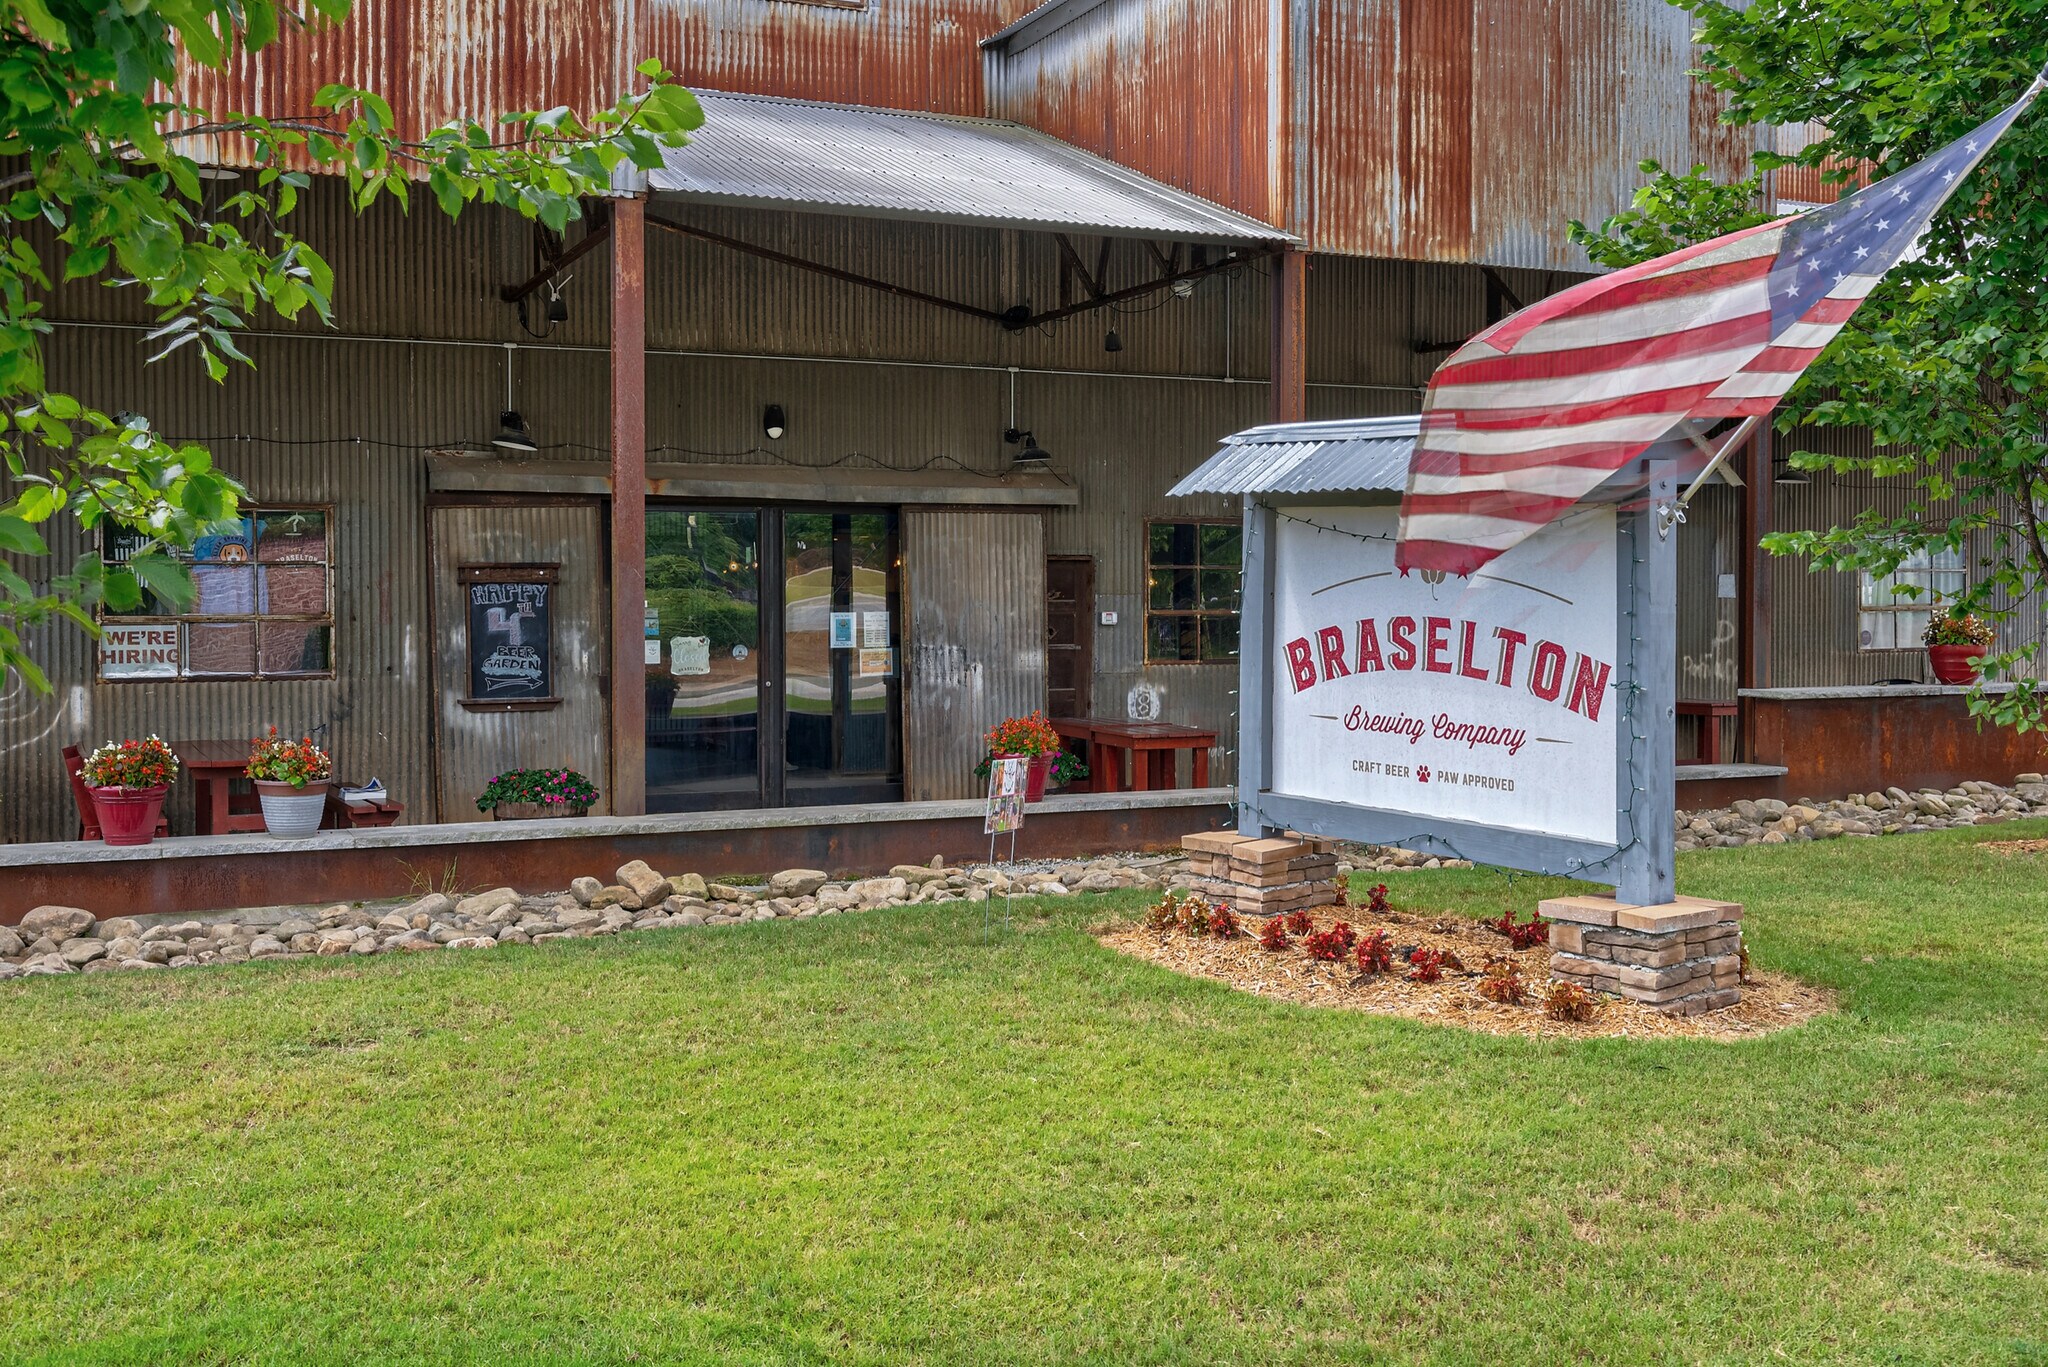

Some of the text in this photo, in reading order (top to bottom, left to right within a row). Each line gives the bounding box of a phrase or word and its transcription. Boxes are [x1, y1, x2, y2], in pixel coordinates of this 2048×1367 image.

[470, 583, 548, 607] HAPPY
[106, 630, 176, 646] WE'RE
[101, 648, 178, 665] HIRING
[496, 645, 535, 659] BEER
[483, 658, 540, 670] GARDEN
[1282, 615, 1612, 723] BRASELTON
[1343, 704, 1527, 756] Brewing Company
[1351, 759, 1515, 792] CRAFT BEER PAW APPROVED
